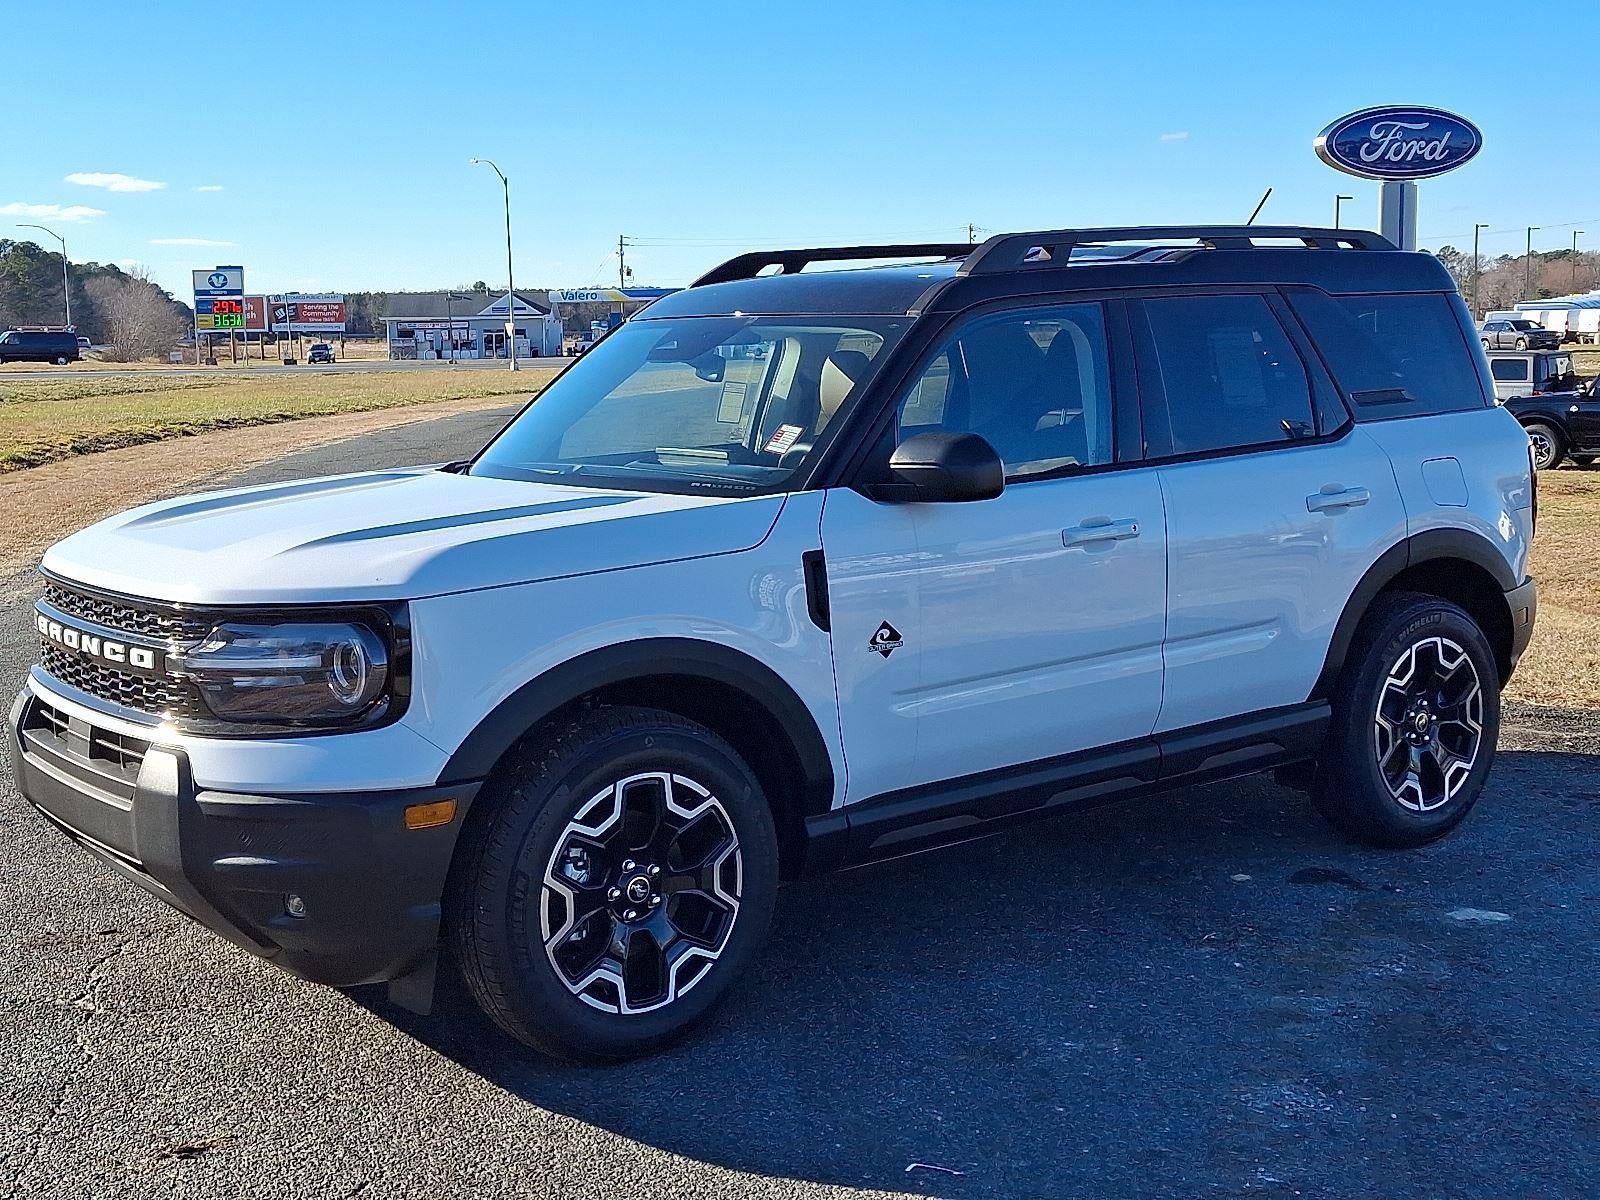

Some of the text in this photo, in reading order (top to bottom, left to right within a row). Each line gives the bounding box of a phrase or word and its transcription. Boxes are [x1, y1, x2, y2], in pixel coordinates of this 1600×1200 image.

[1360, 121, 1451, 162] Ford
[560, 291, 598, 301] Valero
[302, 310, 340, 318] Community
[37, 615, 155, 670] BRONCO
